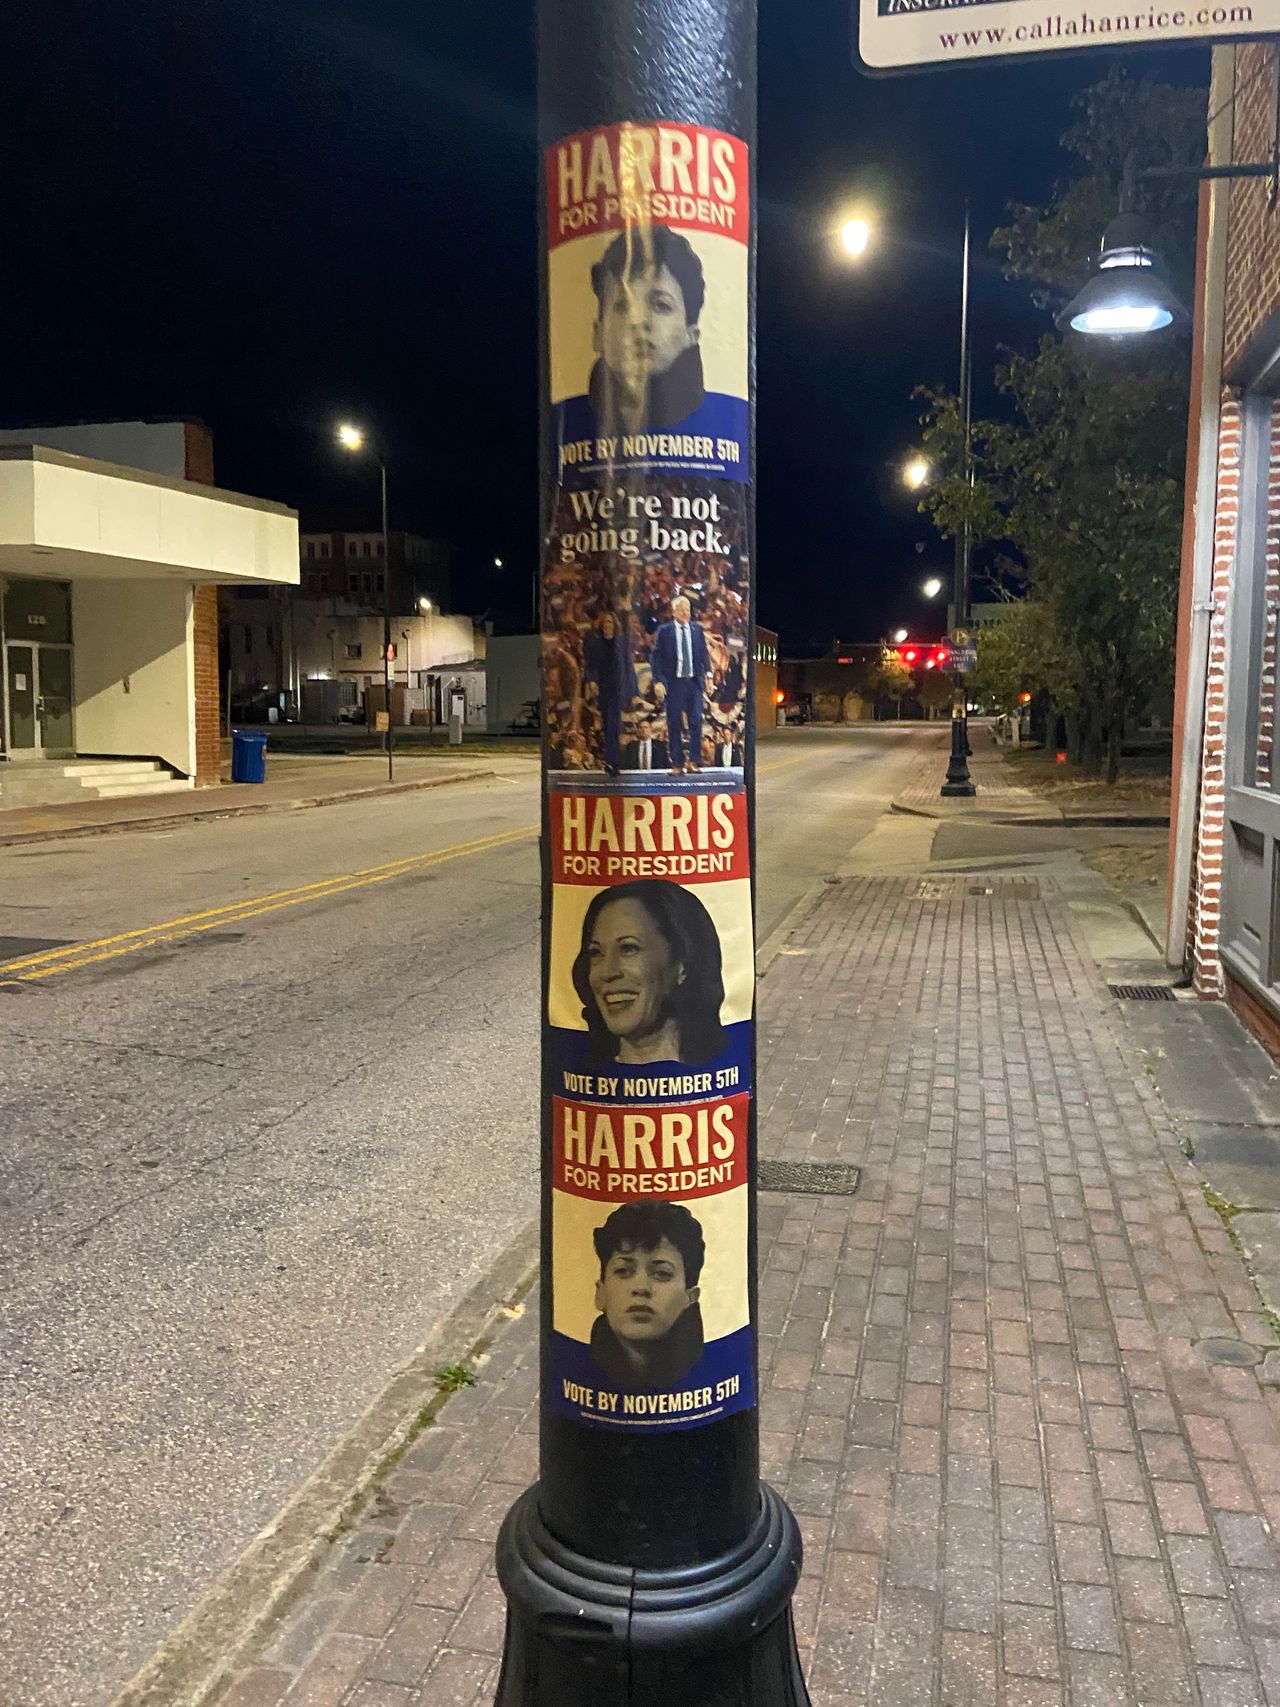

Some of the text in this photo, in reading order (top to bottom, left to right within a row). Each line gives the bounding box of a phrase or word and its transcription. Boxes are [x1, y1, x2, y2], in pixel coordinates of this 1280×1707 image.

[938, 5, 1254, 50] www.callahanrice.com
[558, 126, 737, 209] HARRIS
[559, 201, 598, 235] FOR
[559, 434, 740, 466] VOTE BY NOVEMBER 5TH
[569, 487, 720, 522] We're not
[560, 519, 731, 563] going back.
[562, 793, 735, 852] HARRIS
[563, 851, 735, 876] FOR PRESIDENT
[563, 1066, 739, 1098] VOTE BY NOVEMBER 5TH
[563, 1104, 735, 1169] HARRIS
[563, 1160, 735, 1193] FOR PRESIDENT
[562, 1374, 740, 1415] VOTE BY NOVEMBER 5TH
